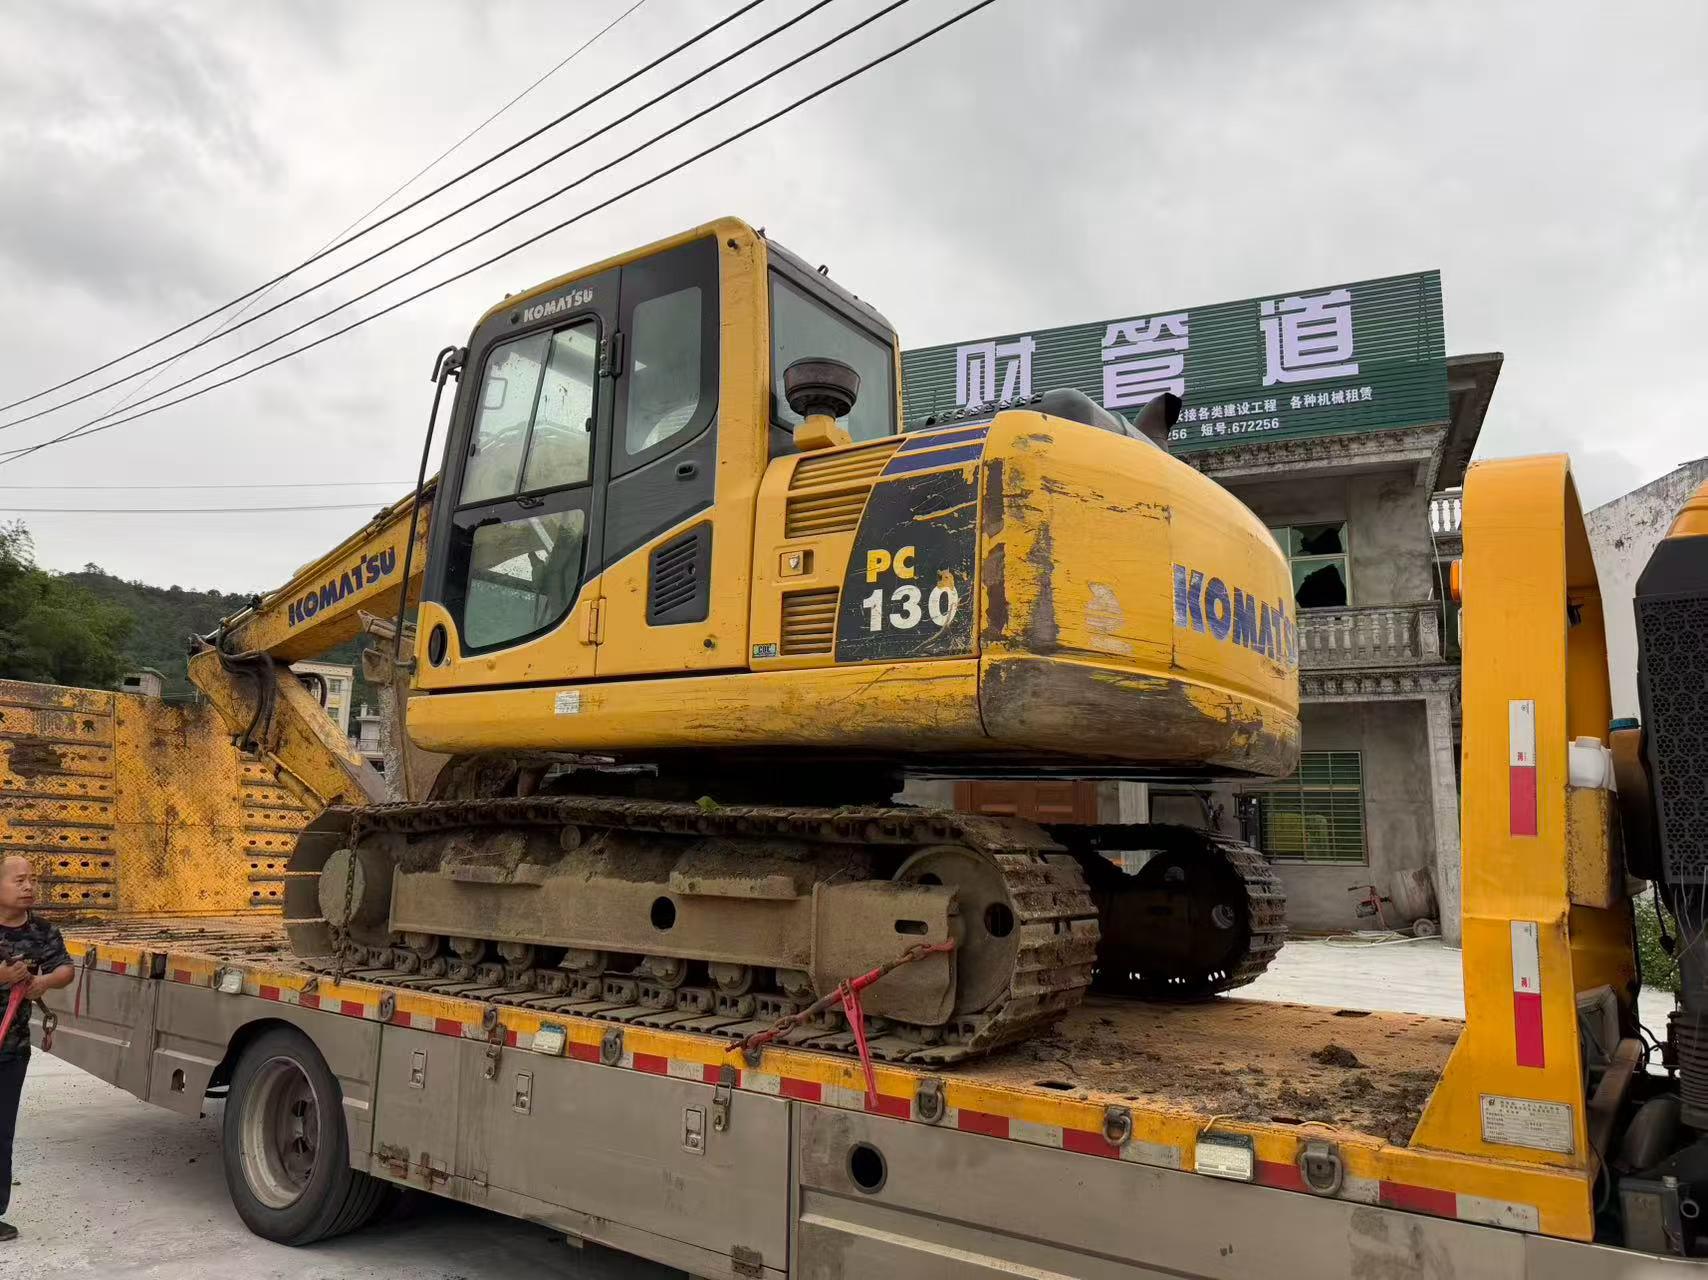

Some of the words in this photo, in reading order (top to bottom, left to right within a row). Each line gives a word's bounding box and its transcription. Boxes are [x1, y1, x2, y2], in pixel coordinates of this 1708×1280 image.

[523, 287, 594, 323] KOMATSU
[1289, 386, 1373, 410] 各种机械租赁
[866, 546, 916, 583] PC
[288, 545, 396, 628] KOMATSU
[862, 584, 960, 632] 130
[1172, 562, 1298, 665] KOMATS
